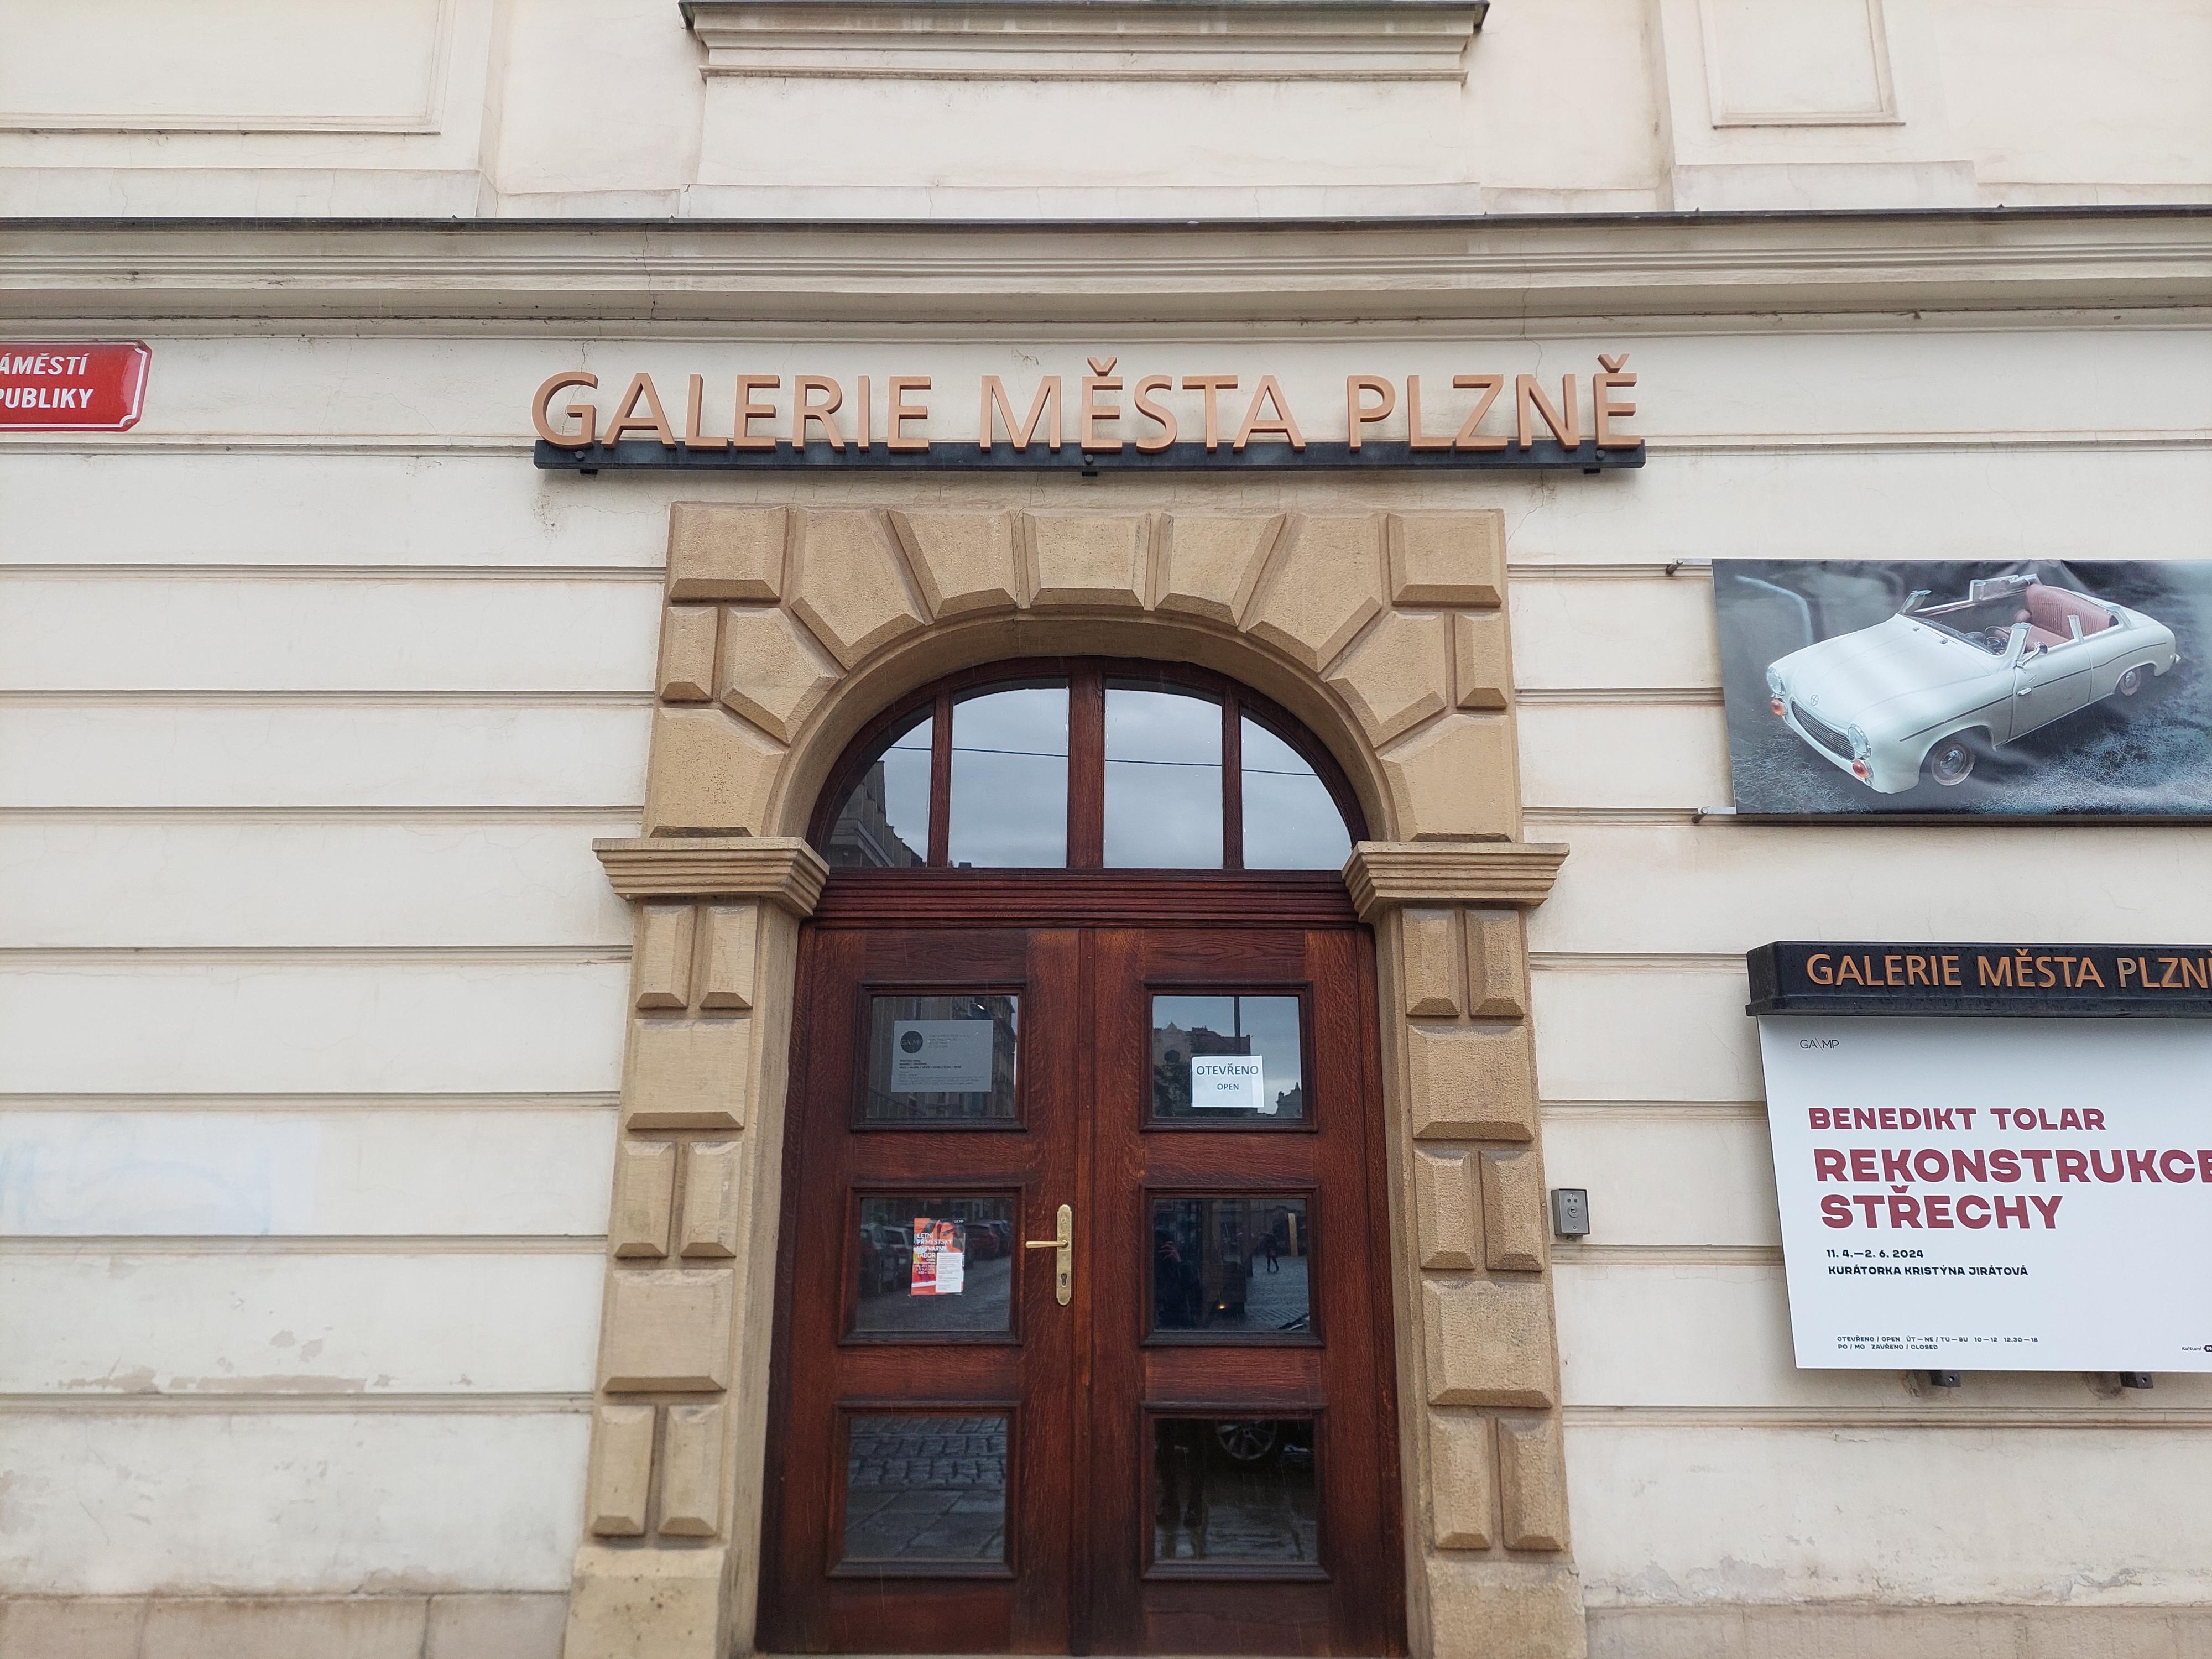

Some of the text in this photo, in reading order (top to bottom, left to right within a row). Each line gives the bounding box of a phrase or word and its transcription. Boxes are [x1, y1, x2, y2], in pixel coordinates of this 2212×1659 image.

[531, 353, 1641, 453] GALERIE MĚSTA PLZNĚ
[1806, 949, 2212, 988] GALERIE MĚSTA PLZN
[1196, 1063, 1259, 1076] OTEVŘENO
[1808, 1108, 2106, 1130] BENEDIKT TOLAR
[1813, 1149, 2212, 1183] REKONSTRUKCE
[1820, 1185, 2063, 1229] STŘECHY
[1826, 1249, 1839, 1258] 11.
[1879, 1249, 1890, 1258] 6.
[1892, 1249, 1924, 1258] 2024
[1828, 1264, 2029, 1276] KURÁTORKA KRISTÝNA JIRÁTOVÁ
